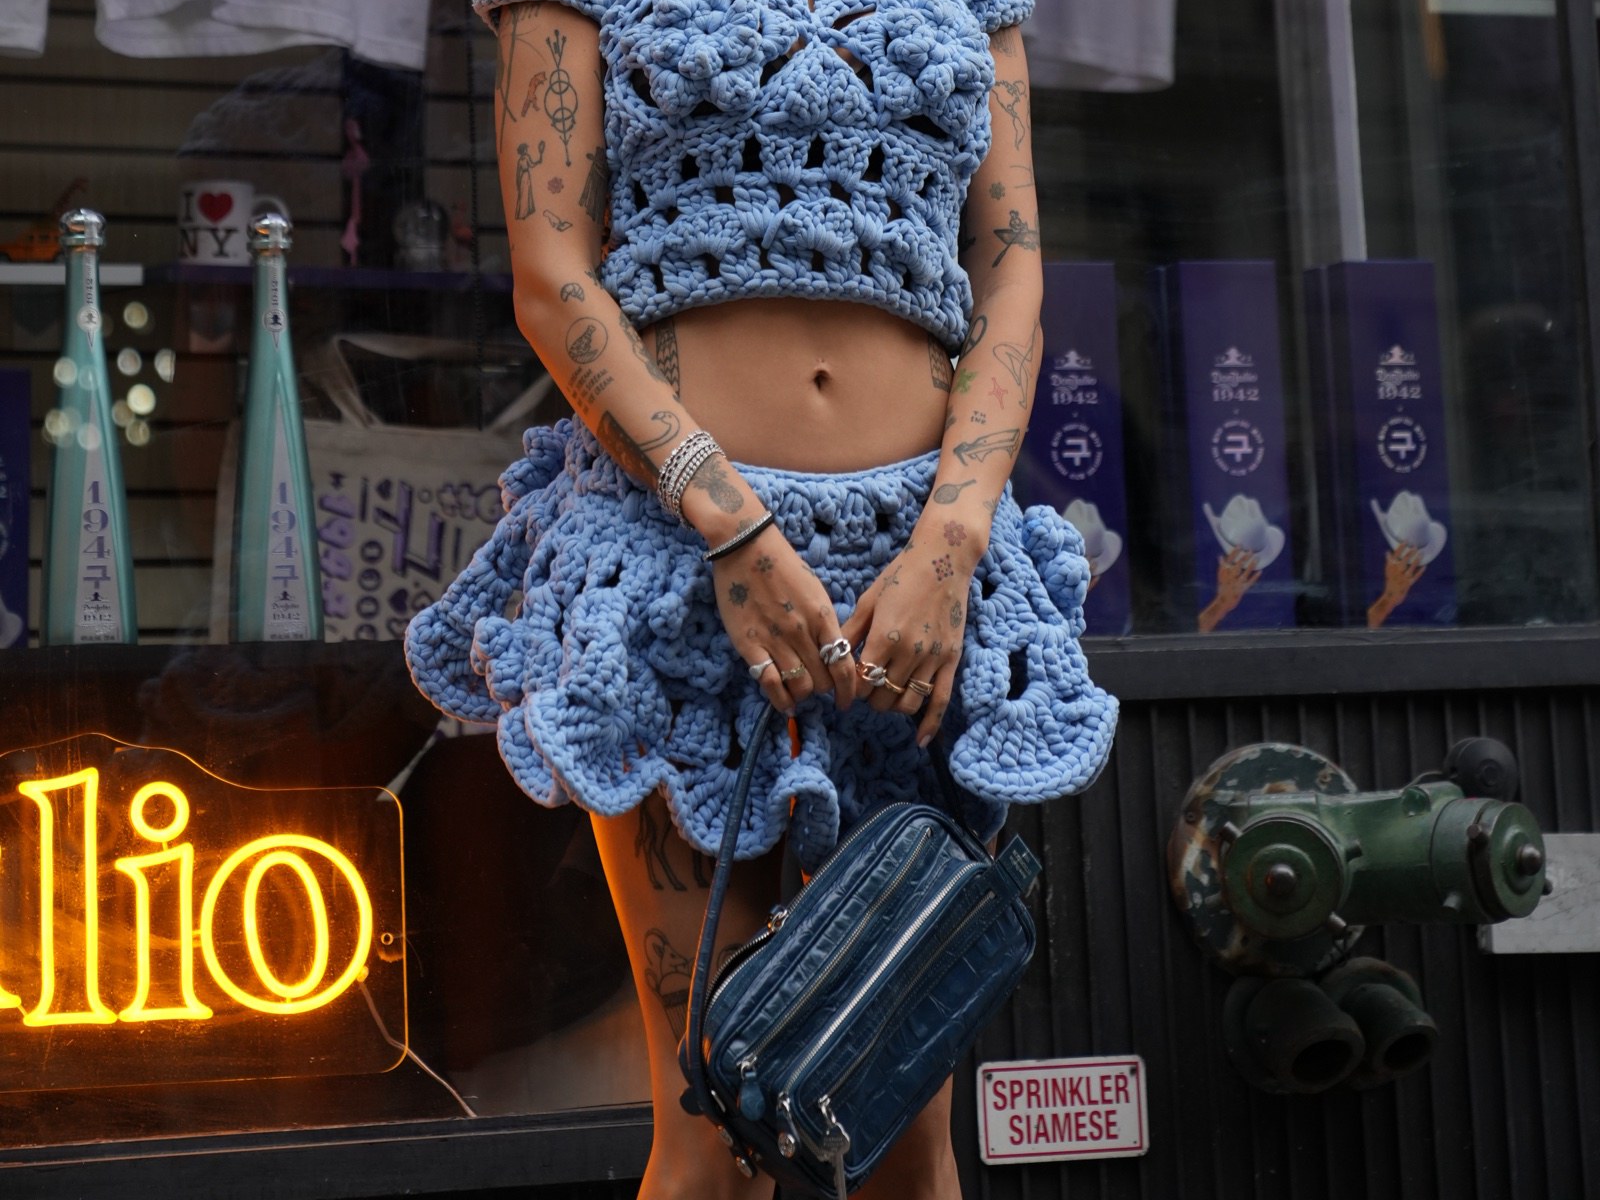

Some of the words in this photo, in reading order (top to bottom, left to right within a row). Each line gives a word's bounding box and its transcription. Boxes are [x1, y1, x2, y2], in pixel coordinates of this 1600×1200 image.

[183, 192, 194, 222] I
[180, 228, 238, 258] NY
[1052, 391, 1098, 405] 1942
[1212, 388, 1259, 402] 1942
[1377, 385, 1421, 400] 1942
[0, 767, 373, 1028] lio
[993, 1074, 1130, 1112] SPRINKLER
[1010, 1109, 1119, 1146] SIAMESE
